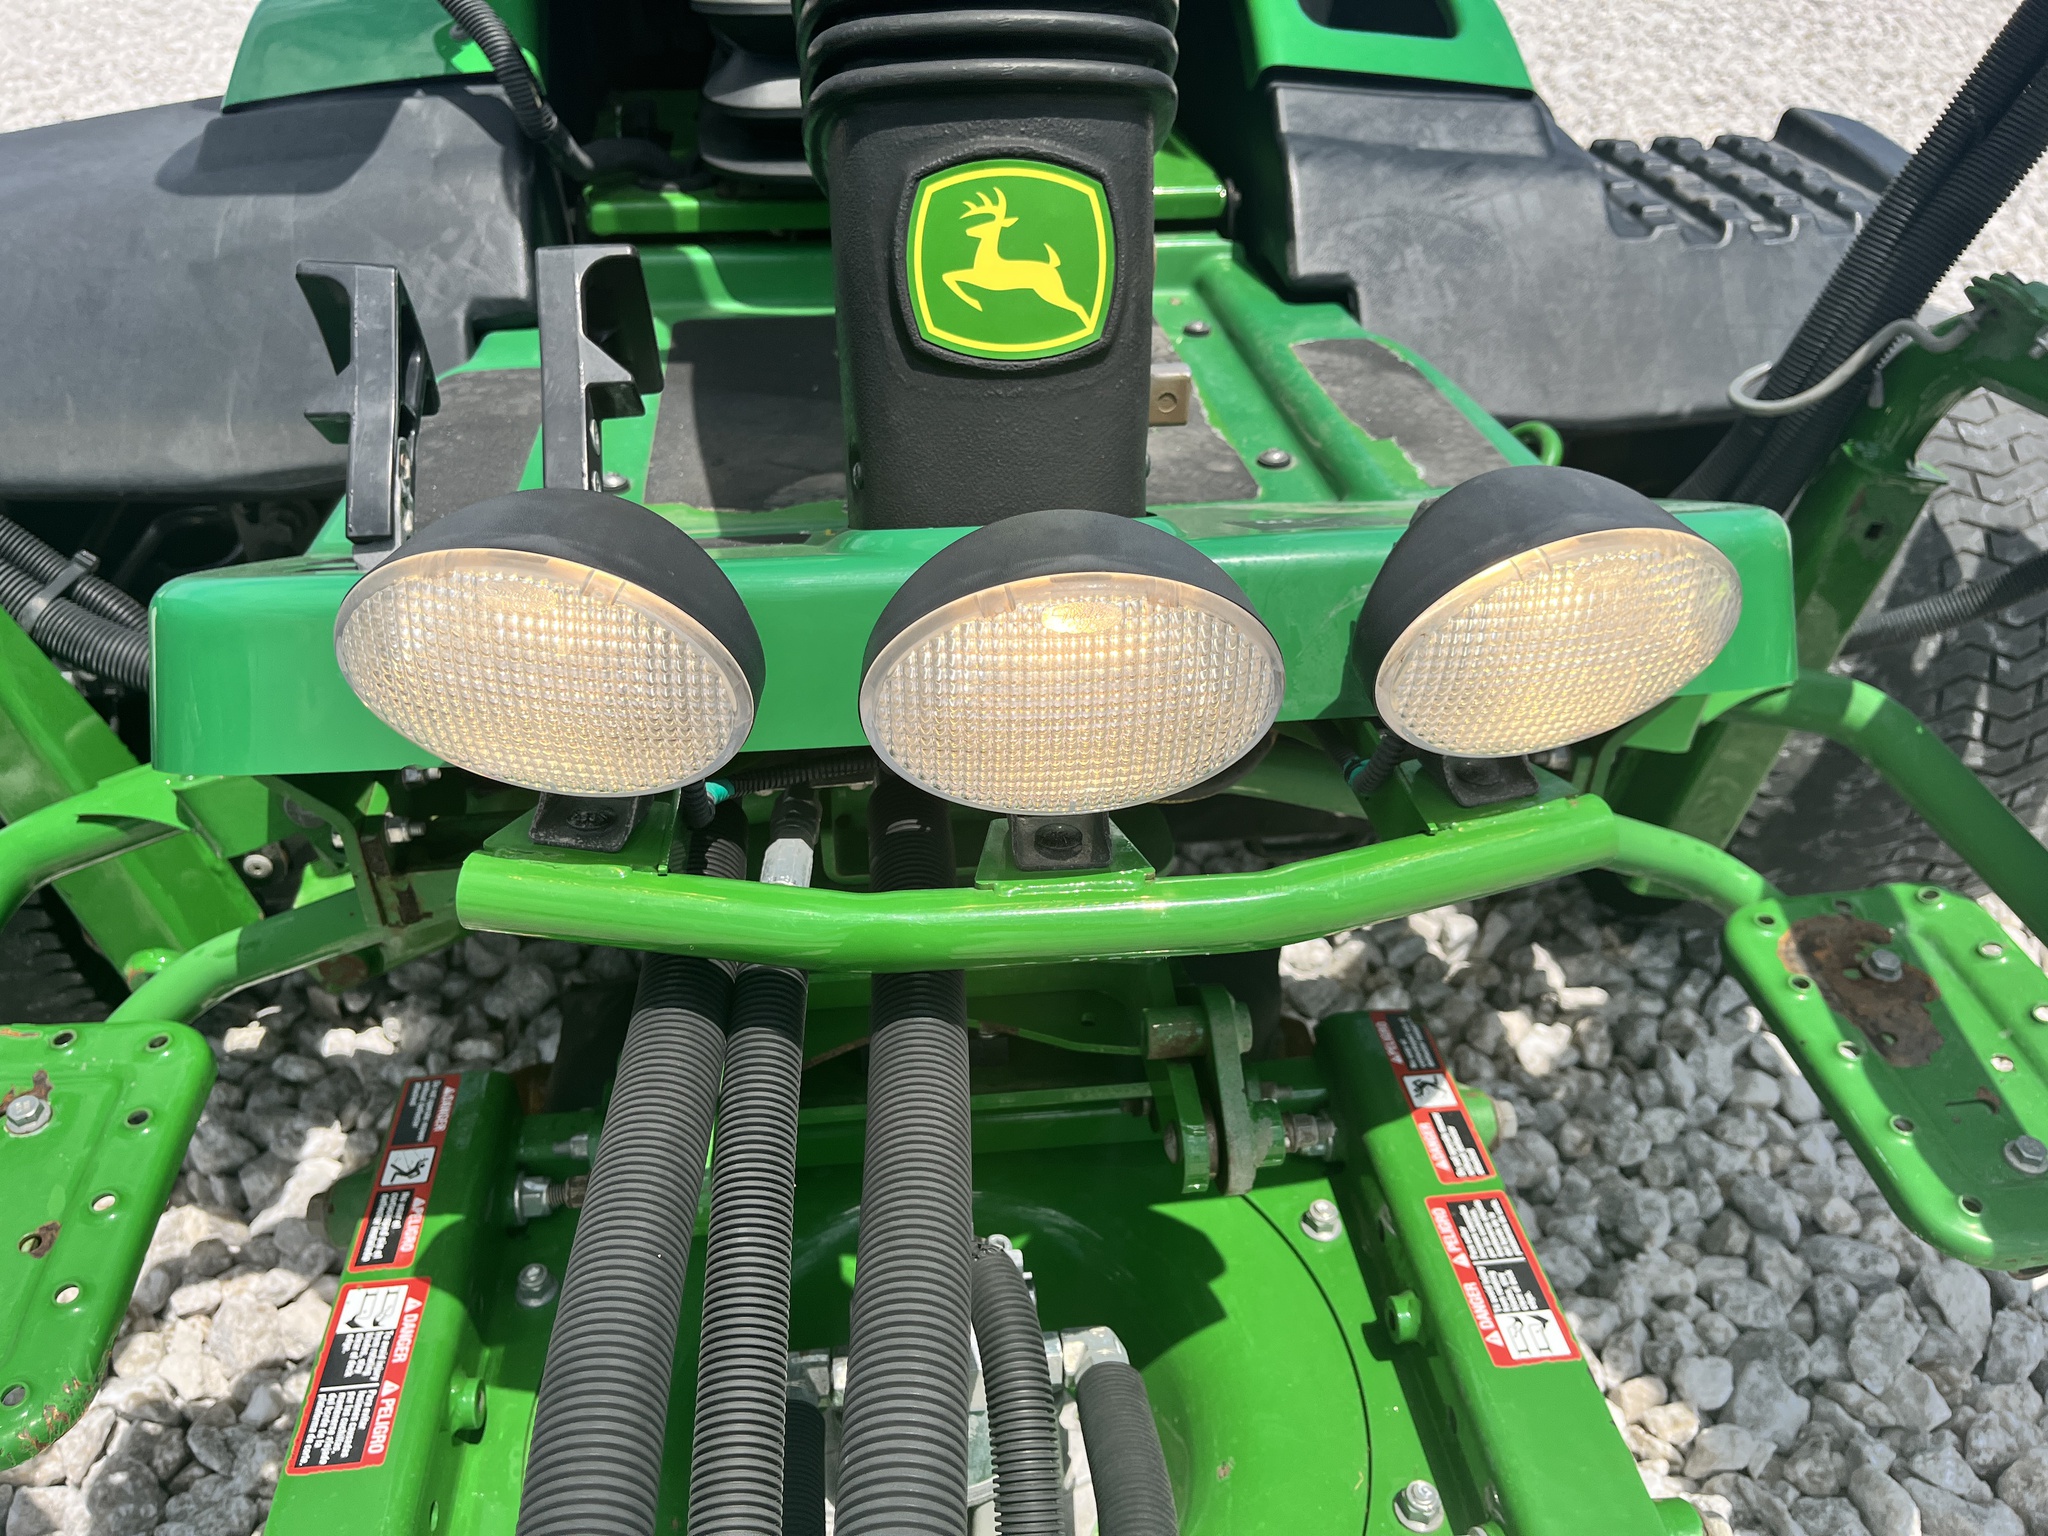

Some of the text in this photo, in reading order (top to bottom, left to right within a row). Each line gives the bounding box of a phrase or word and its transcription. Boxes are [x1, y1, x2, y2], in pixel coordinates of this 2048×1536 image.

[397, 1205, 425, 1253] PELIGRO
[1429, 1206, 1463, 1252] PELIGRO
[1461, 1281, 1496, 1330] DANGER
[390, 1312, 419, 1363] DANGER
[366, 1397, 397, 1455] PELIGRO
